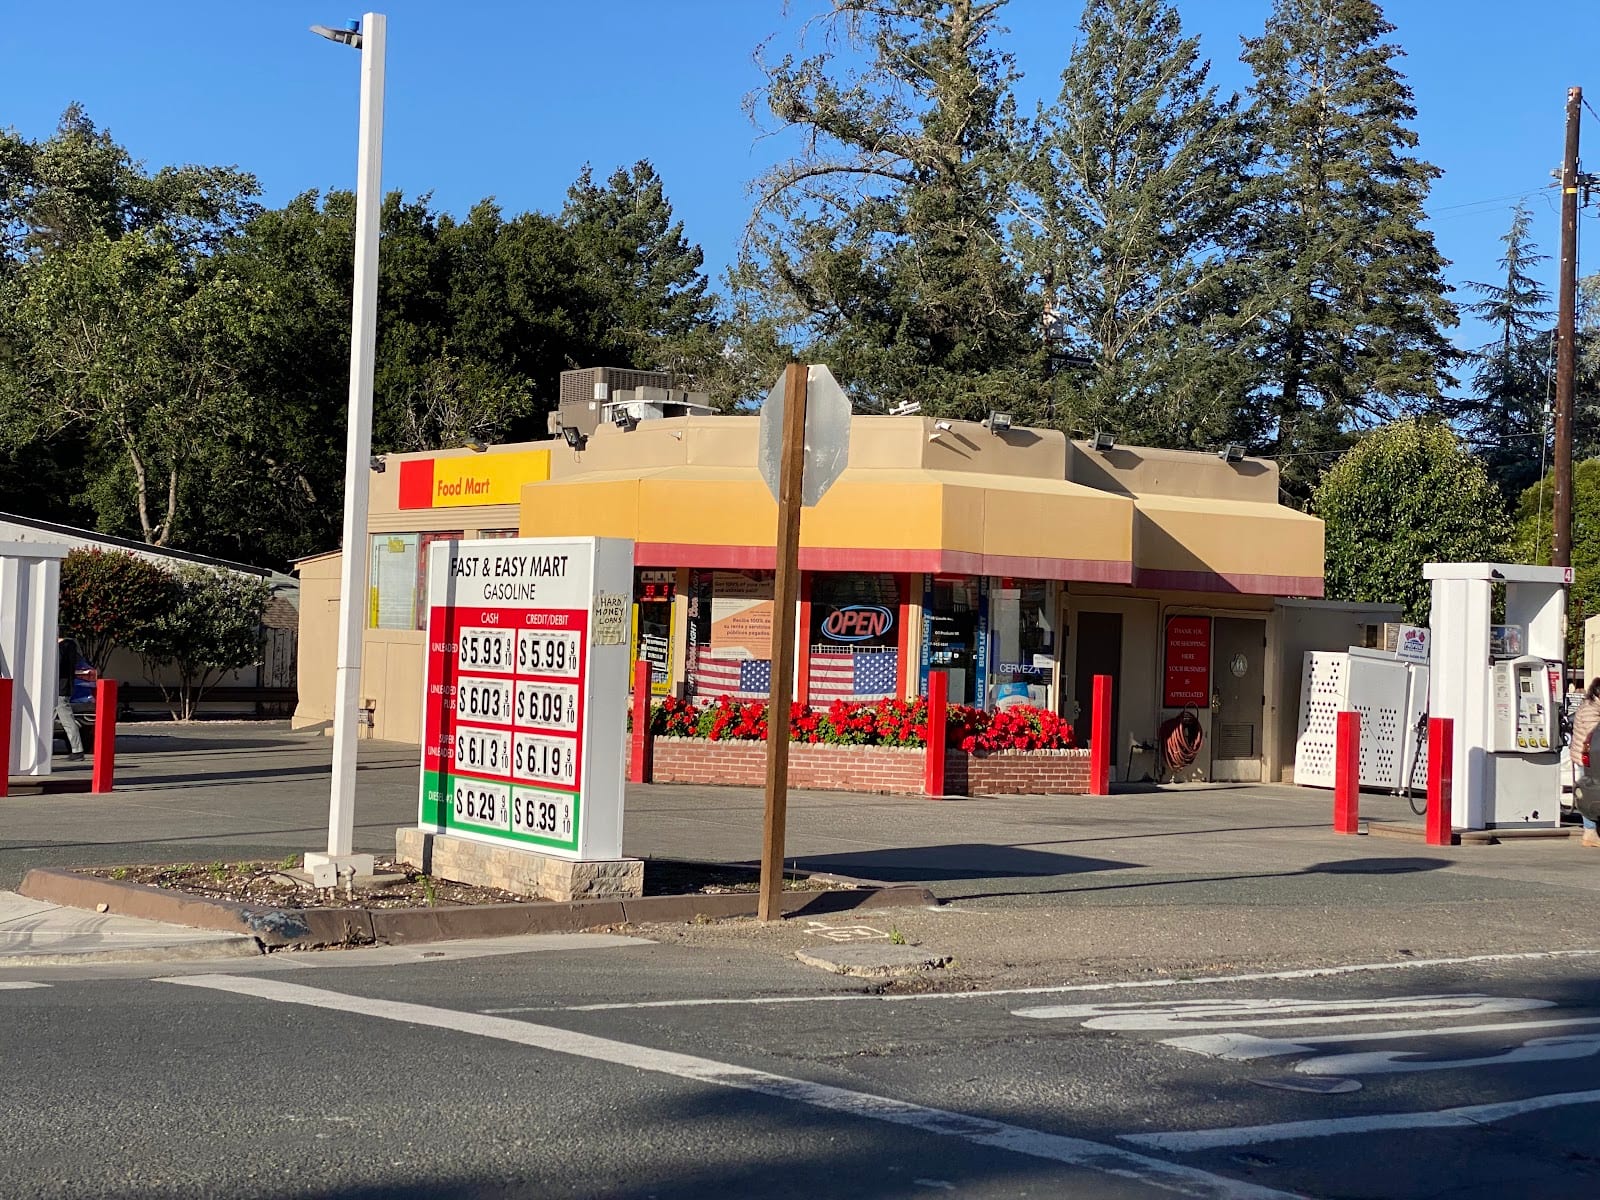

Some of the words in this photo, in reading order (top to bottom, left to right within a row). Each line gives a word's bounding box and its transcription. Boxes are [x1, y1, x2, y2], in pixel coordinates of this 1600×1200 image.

[438, 477, 462, 496] Food
[464, 478, 490, 494] Mart
[450, 558, 480, 577] FAST
[482, 558, 490, 577] &
[494, 556, 528, 577] EASY
[530, 556, 568, 577] MART
[1565, 568, 1572, 582] 4
[484, 583, 536, 600] GASOLINE
[600, 597, 621, 606] HARD
[480, 612, 499, 624] CASH
[595, 608, 624, 616] MONEY
[526, 614, 568, 626] CREDIT/DEBIT
[600, 617, 622, 625] LOANS
[828, 610, 885, 636] OPEN
[922, 613, 930, 644] LIGHT
[432, 642, 458, 653] UNLEADED
[1000, 663, 1040, 674] CERVEZA
[430, 684, 456, 695] UNLEADED
[976, 678, 984, 708] LIGHT
[444, 699, 456, 710] PLUS
[438, 734, 455, 745] SUPER
[427, 747, 454, 758] UNLEADED
[428, 791, 444, 803] DIESEL
